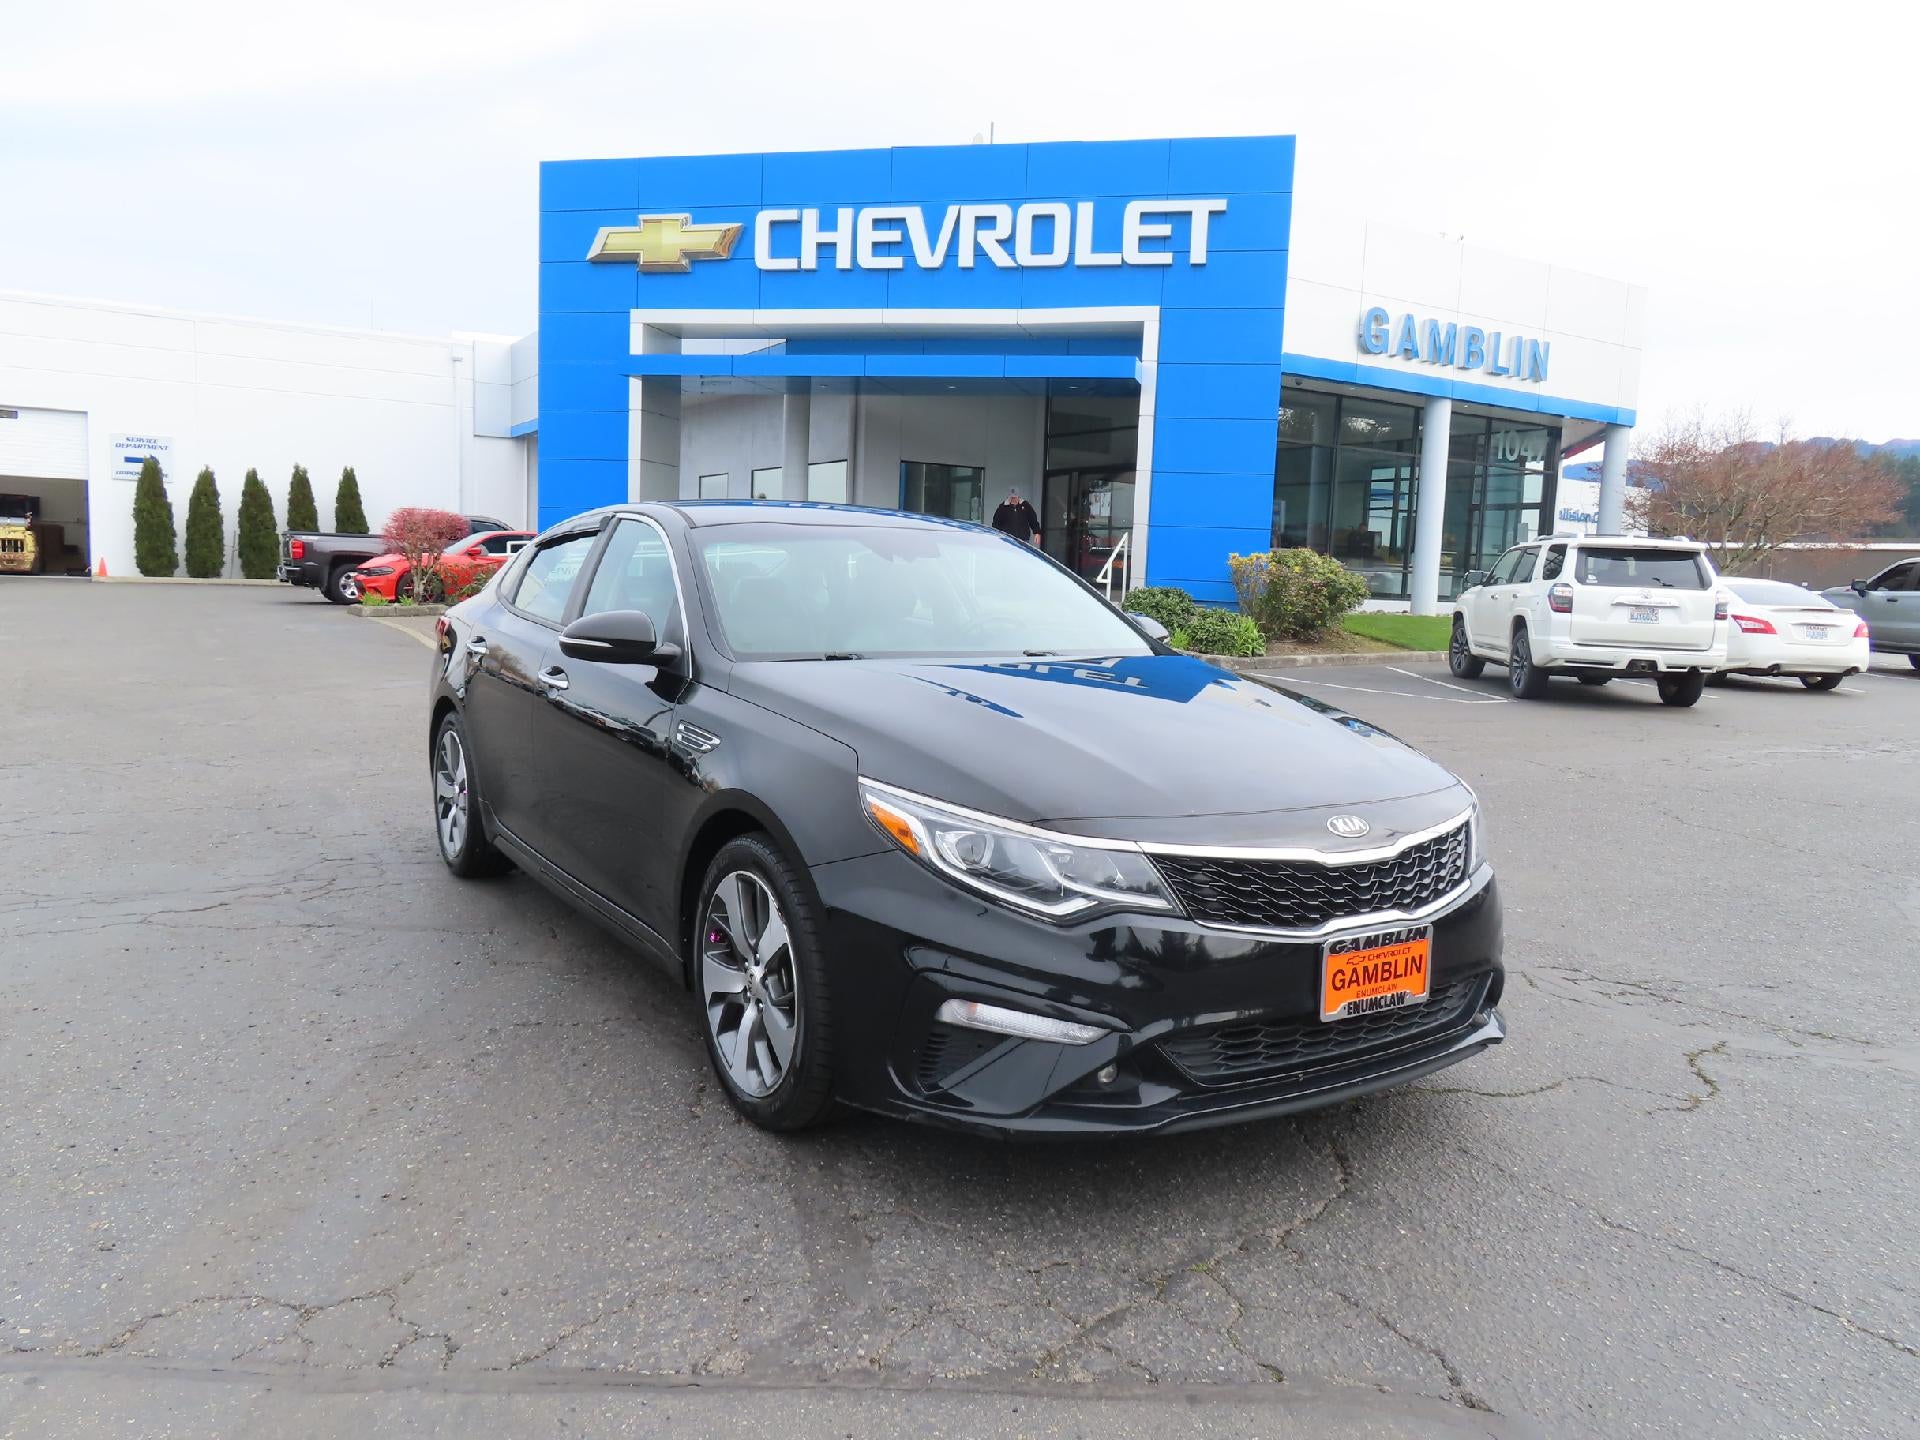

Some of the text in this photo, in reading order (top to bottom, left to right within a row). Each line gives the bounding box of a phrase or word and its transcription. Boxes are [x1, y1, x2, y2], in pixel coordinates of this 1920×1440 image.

[754, 198, 1227, 271] CHEVROLET
[1359, 306, 1550, 382] GAMBLIN
[115, 442, 169, 451] DEPARTMENT
[1329, 817, 1367, 834] KIA
[1328, 926, 1428, 955] GAMBLIN
[1367, 947, 1412, 961] CHEVROLET
[1331, 954, 1424, 991] GAMBLIN
[1346, 991, 1407, 1016] ENUMCLAW
[1356, 984, 1398, 998] ENUMCLAW
